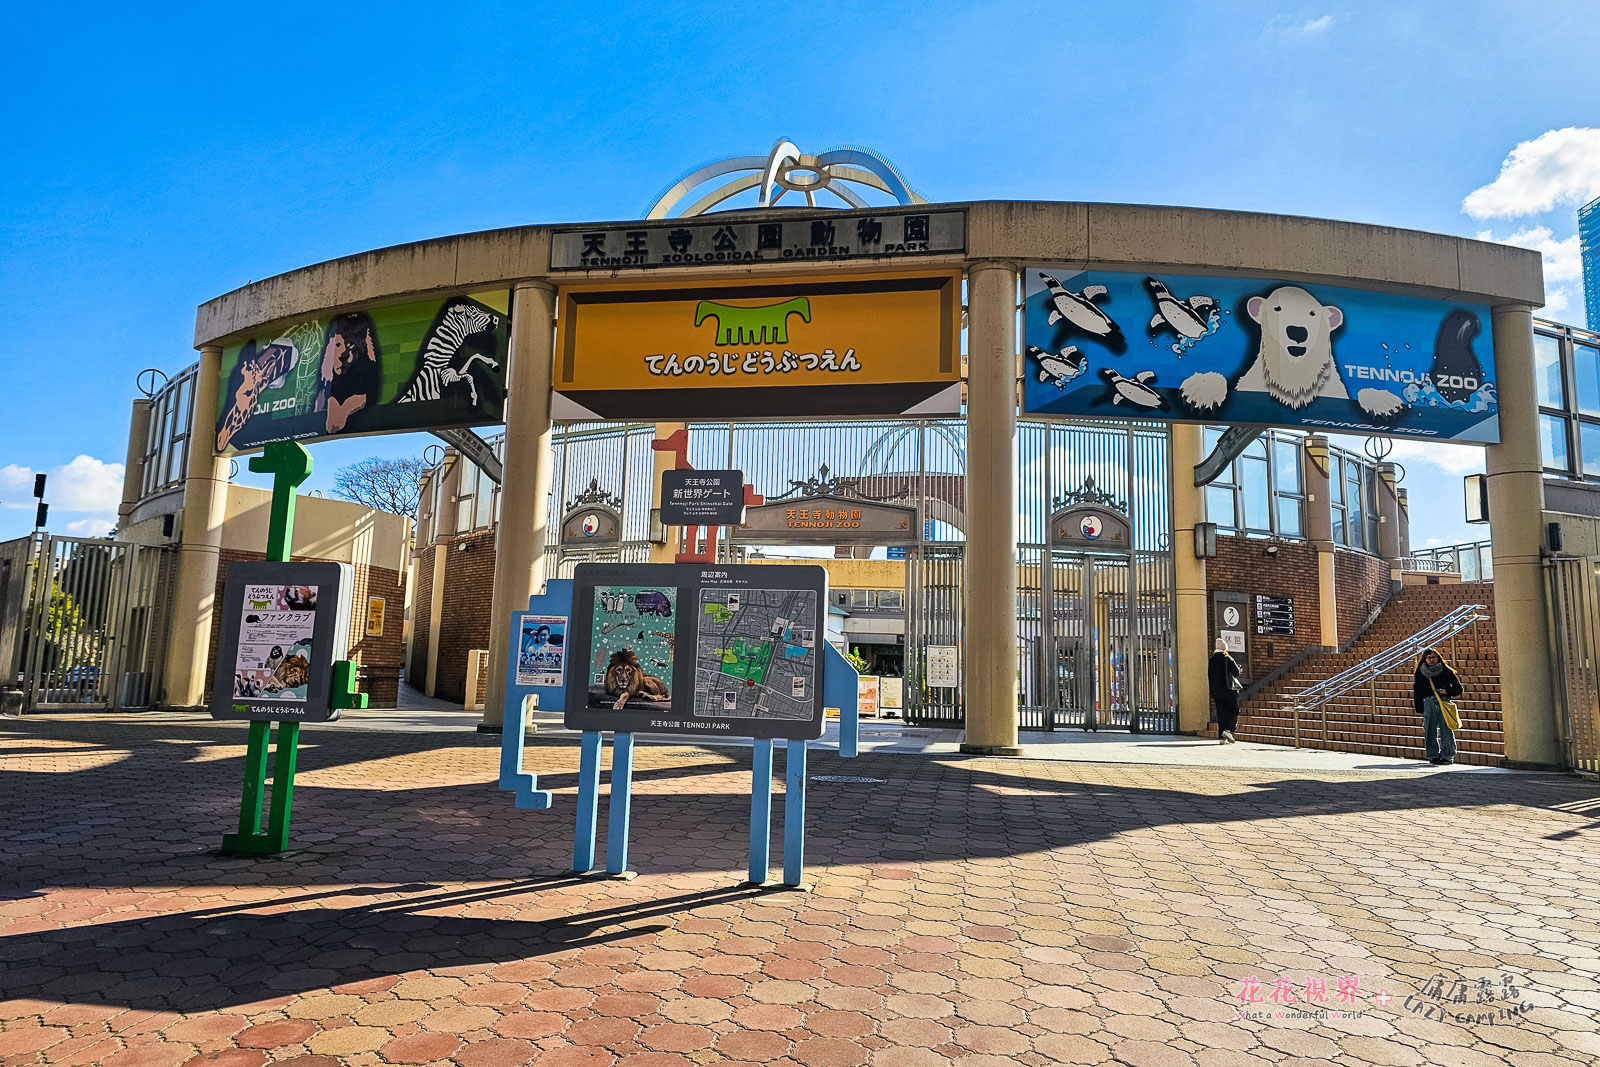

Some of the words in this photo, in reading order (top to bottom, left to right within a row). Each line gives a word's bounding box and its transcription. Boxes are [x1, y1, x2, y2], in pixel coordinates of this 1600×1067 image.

[581, 255, 645, 266] TENNOJI
[662, 249, 763, 263] ZOOLOGICAL
[783, 246, 850, 258] GARDEN
[884, 241, 930, 253] PARK
[1437, 374, 1478, 390] ZOO
[271, 397, 297, 412] ZOO
[1301, 418, 1390, 431] TENNOJI
[1393, 427, 1439, 435] ZOO
[685, 478, 721, 486] 天王寺公園
[673, 488, 731, 499] 新世界ゲート
[786, 509, 862, 520] 天王寺動物園
[787, 521, 834, 529] TENNOJI
[836, 521, 860, 529] ZOO
[262, 612, 312, 622] ファンクラブ
[251, 705, 305, 714] てんのうじどうぶつえん
[650, 720, 680, 728] 天王寺公園
[683, 721, 711, 729] TENNOJI
[712, 722, 731, 730] PARK
